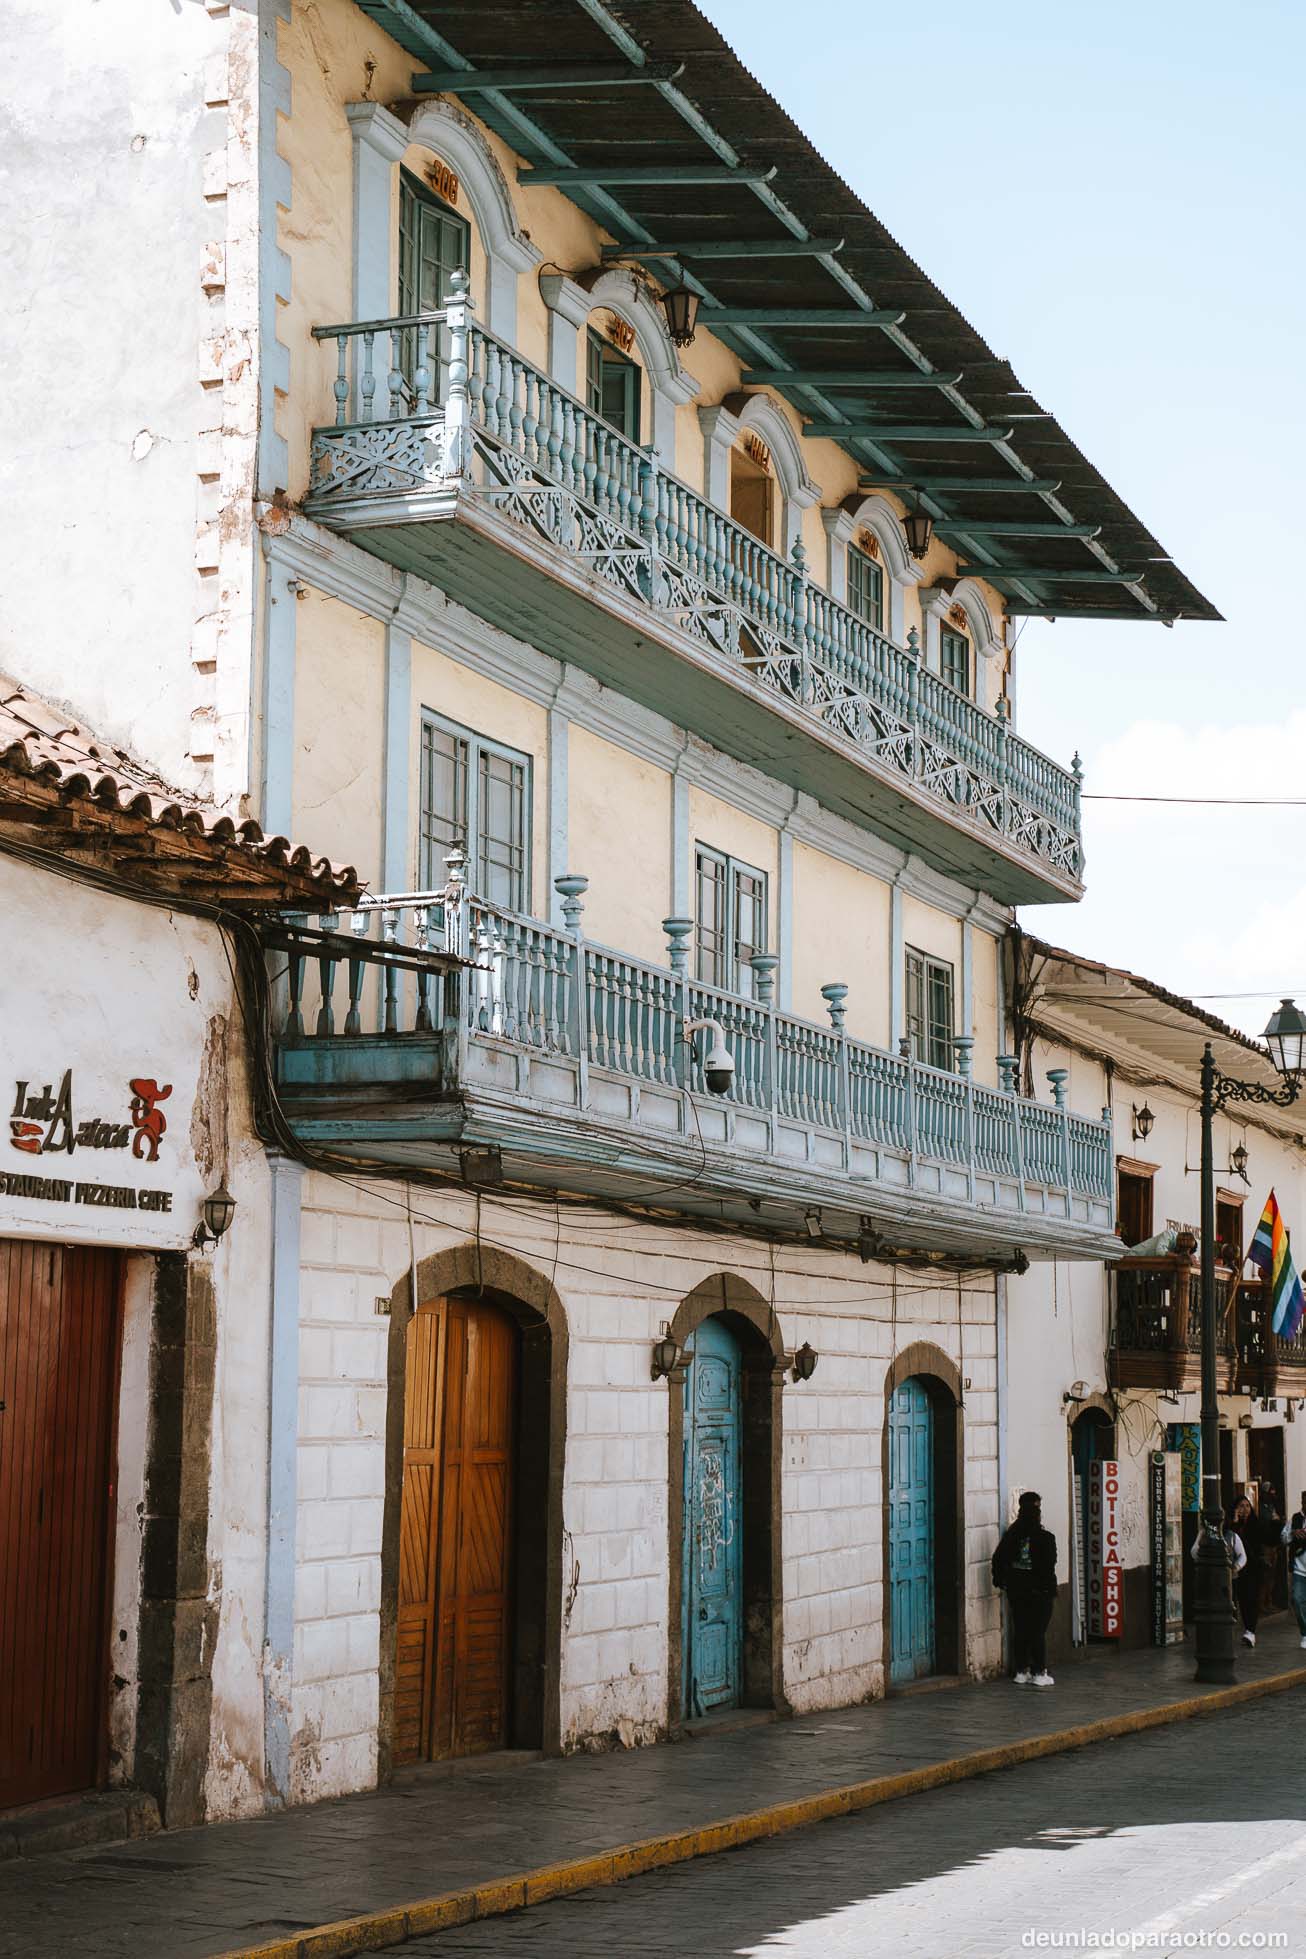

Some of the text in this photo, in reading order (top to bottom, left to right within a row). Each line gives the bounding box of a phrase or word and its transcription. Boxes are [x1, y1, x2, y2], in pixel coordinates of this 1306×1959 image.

[75, 1182, 137, 1208] PIZZERIA
[138, 1189, 173, 1212] CAFE
[1155, 1469, 1163, 1502] TOURS
[1090, 1462, 1101, 1633] DRUGSTORE
[1105, 1462, 1119, 1633] BOTICA SHOP
[1155, 1503, 1163, 1577] INFORMATION
